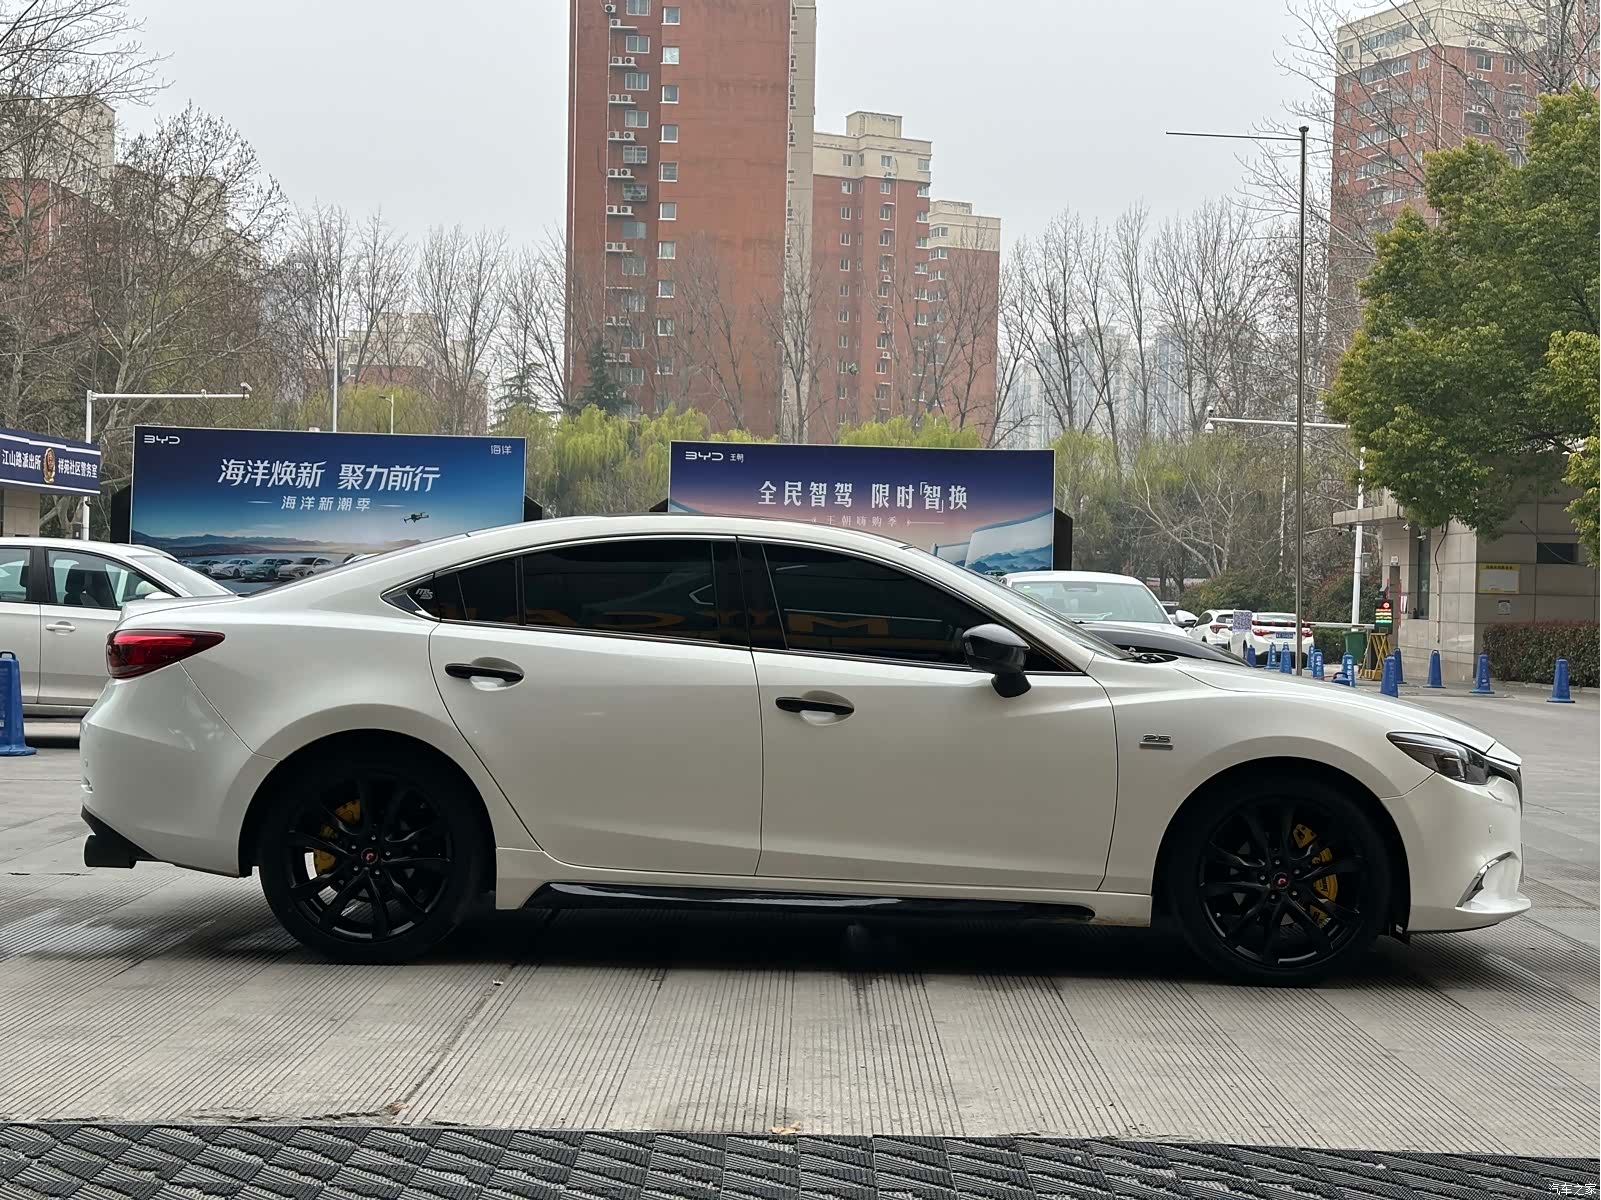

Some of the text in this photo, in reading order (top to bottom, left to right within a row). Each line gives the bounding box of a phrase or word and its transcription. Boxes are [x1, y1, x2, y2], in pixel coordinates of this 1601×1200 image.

[144, 435, 180, 444] BYD
[491, 445, 512, 455] 海洋
[685, 451, 724, 461] BYD
[2, 449, 98, 479] 江山路派出所 祥苑社区警务室
[729, 453, 744, 463] 王朝
[217, 459, 441, 492] 海洋焕新 聚力前行
[758, 480, 853, 508] 全民智驾
[281, 495, 371, 512] 海洋新潮季
